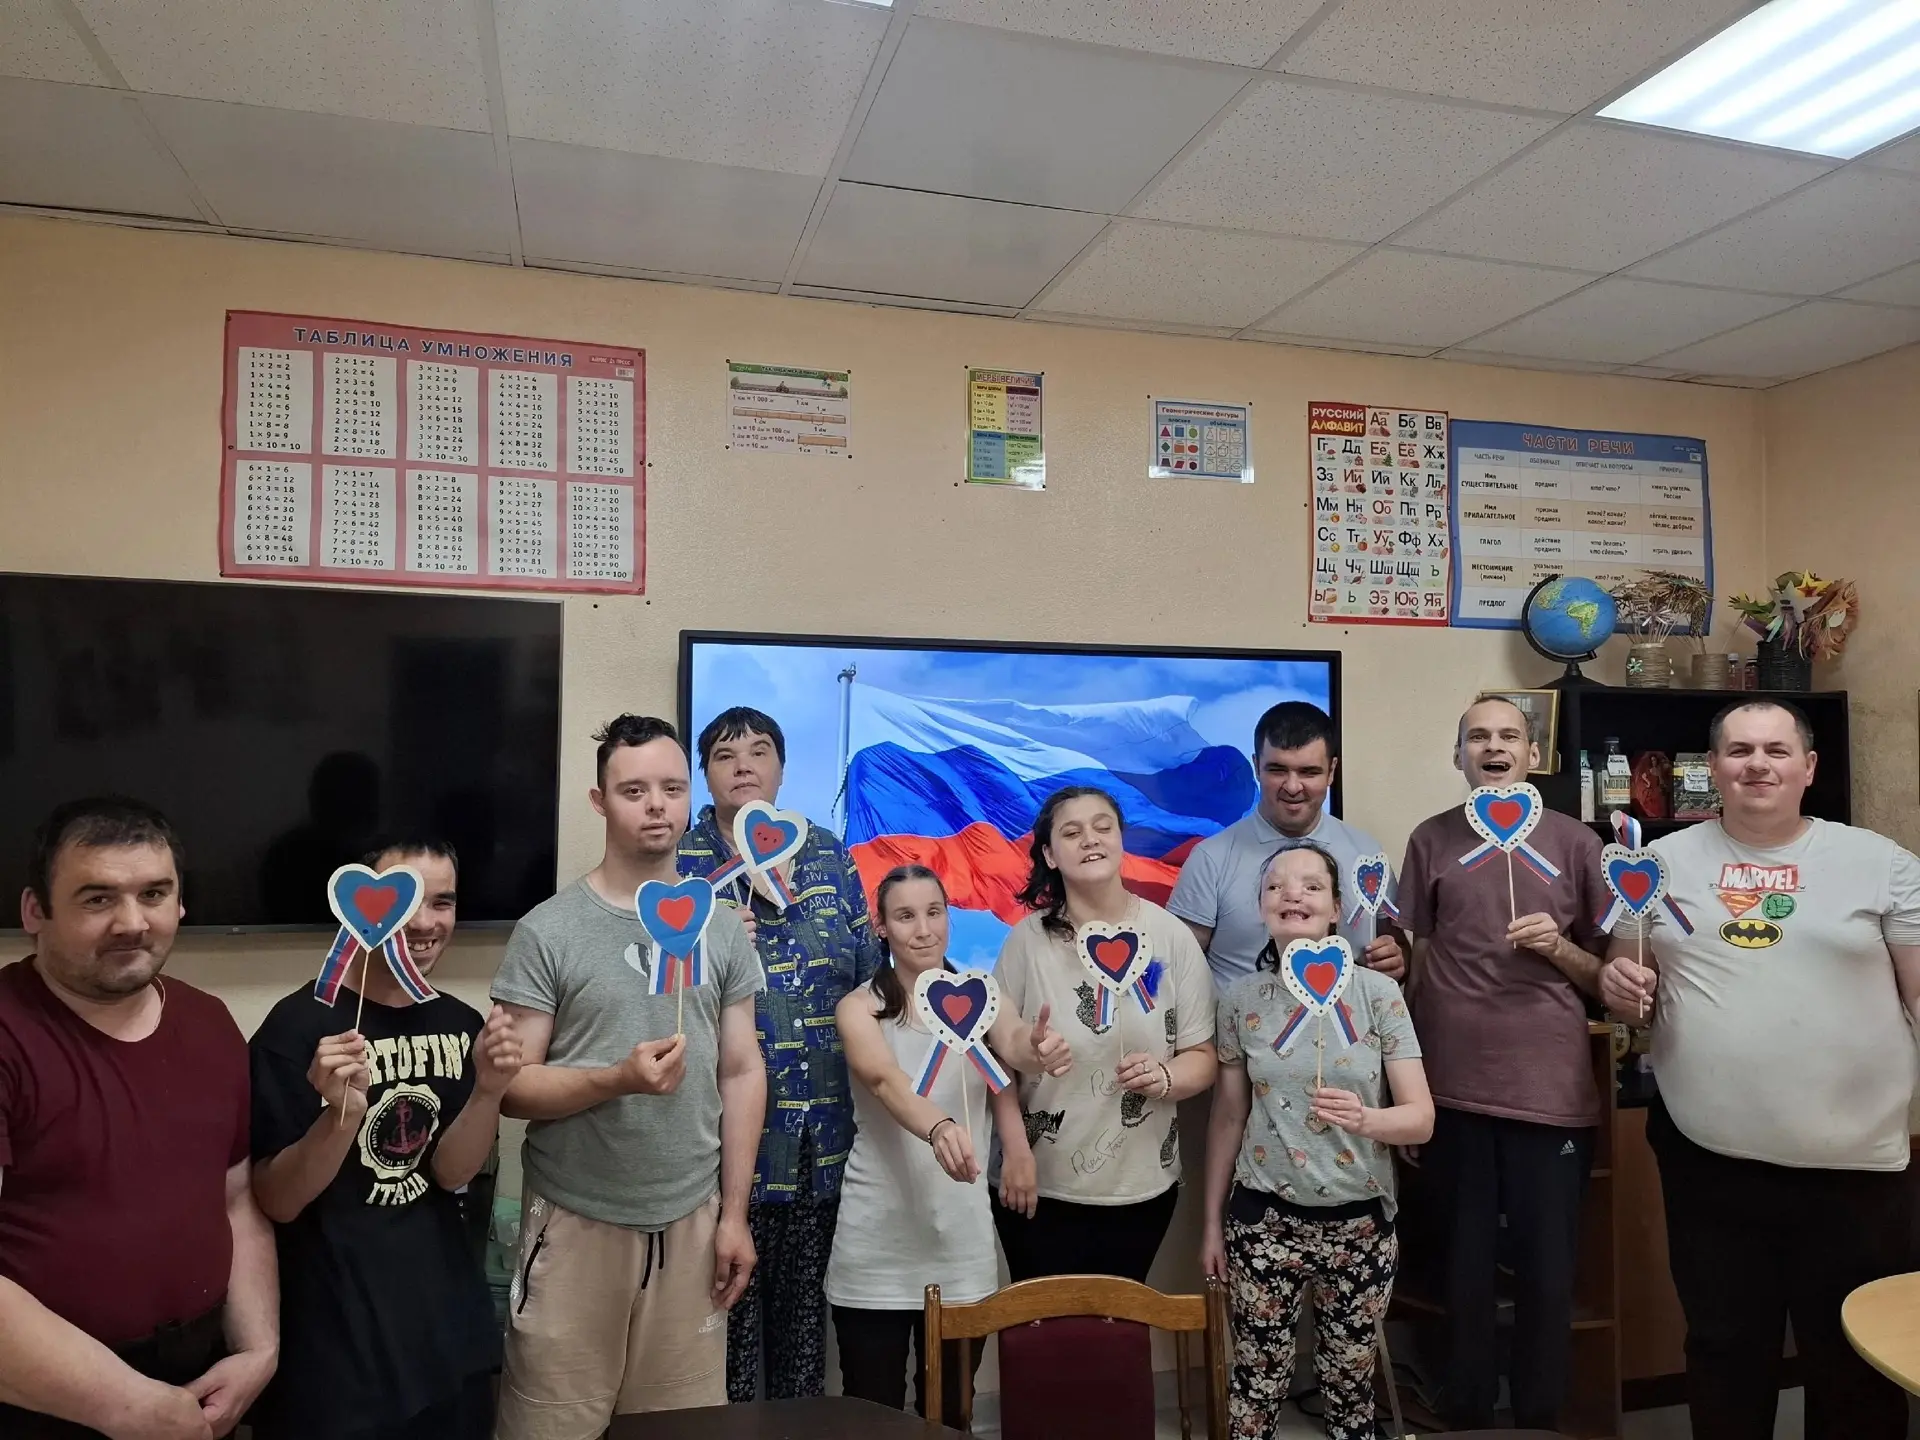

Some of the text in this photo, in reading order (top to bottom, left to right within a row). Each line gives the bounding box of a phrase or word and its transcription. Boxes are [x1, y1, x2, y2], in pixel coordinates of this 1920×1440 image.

[294, 328, 573, 368] ТАБЛИЦА УМНОЖЕНИЯ
[976, 374, 1035, 384] МЕРЫ ВЕЛИЧИН
[1162, 407, 1214, 416] Геометрические
[1312, 407, 1364, 421] РУССКИЙ
[1311, 420, 1364, 433] АЛФАВИТ
[1370, 412, 1442, 430] Аа Бб Вв
[1317, 438, 1445, 459] Гг Дд Ее Ёё Жж
[1522, 432, 1634, 455] ЧАСТИ РЕЧИ
[1530, 458, 1560, 466] ОБОЗНАЧАЕТ
[1317, 467, 1441, 488] Зз Ии Йй Кк Лл
[1461, 481, 1518, 490] СУЩЕСТВИТЕЛЬНОЕ
[1317, 497, 1441, 519] Мм Нн Оо Пп Рр
[1464, 512, 1516, 520] ПРИЛАГАТЕЛЬНОЕ
[1318, 527, 1444, 548] Сс Тт Уу Фф Хх
[1317, 558, 1336, 572] Цц
[1345, 559, 1361, 573] Чч
[1370, 560, 1393, 574] Шш
[1397, 562, 1419, 577] Щщ
[1369, 591, 1388, 604] Ээ
[1395, 592, 1418, 606] Юю
[1424, 593, 1441, 606] Яя
[1722, 866, 1794, 890] MARVEL
[821, 999, 835, 1010] LaR
[816, 1028, 839, 1042] L'AR
[362, 1032, 472, 1085] RTOFIN
[366, 1172, 429, 1206] ITALIA
